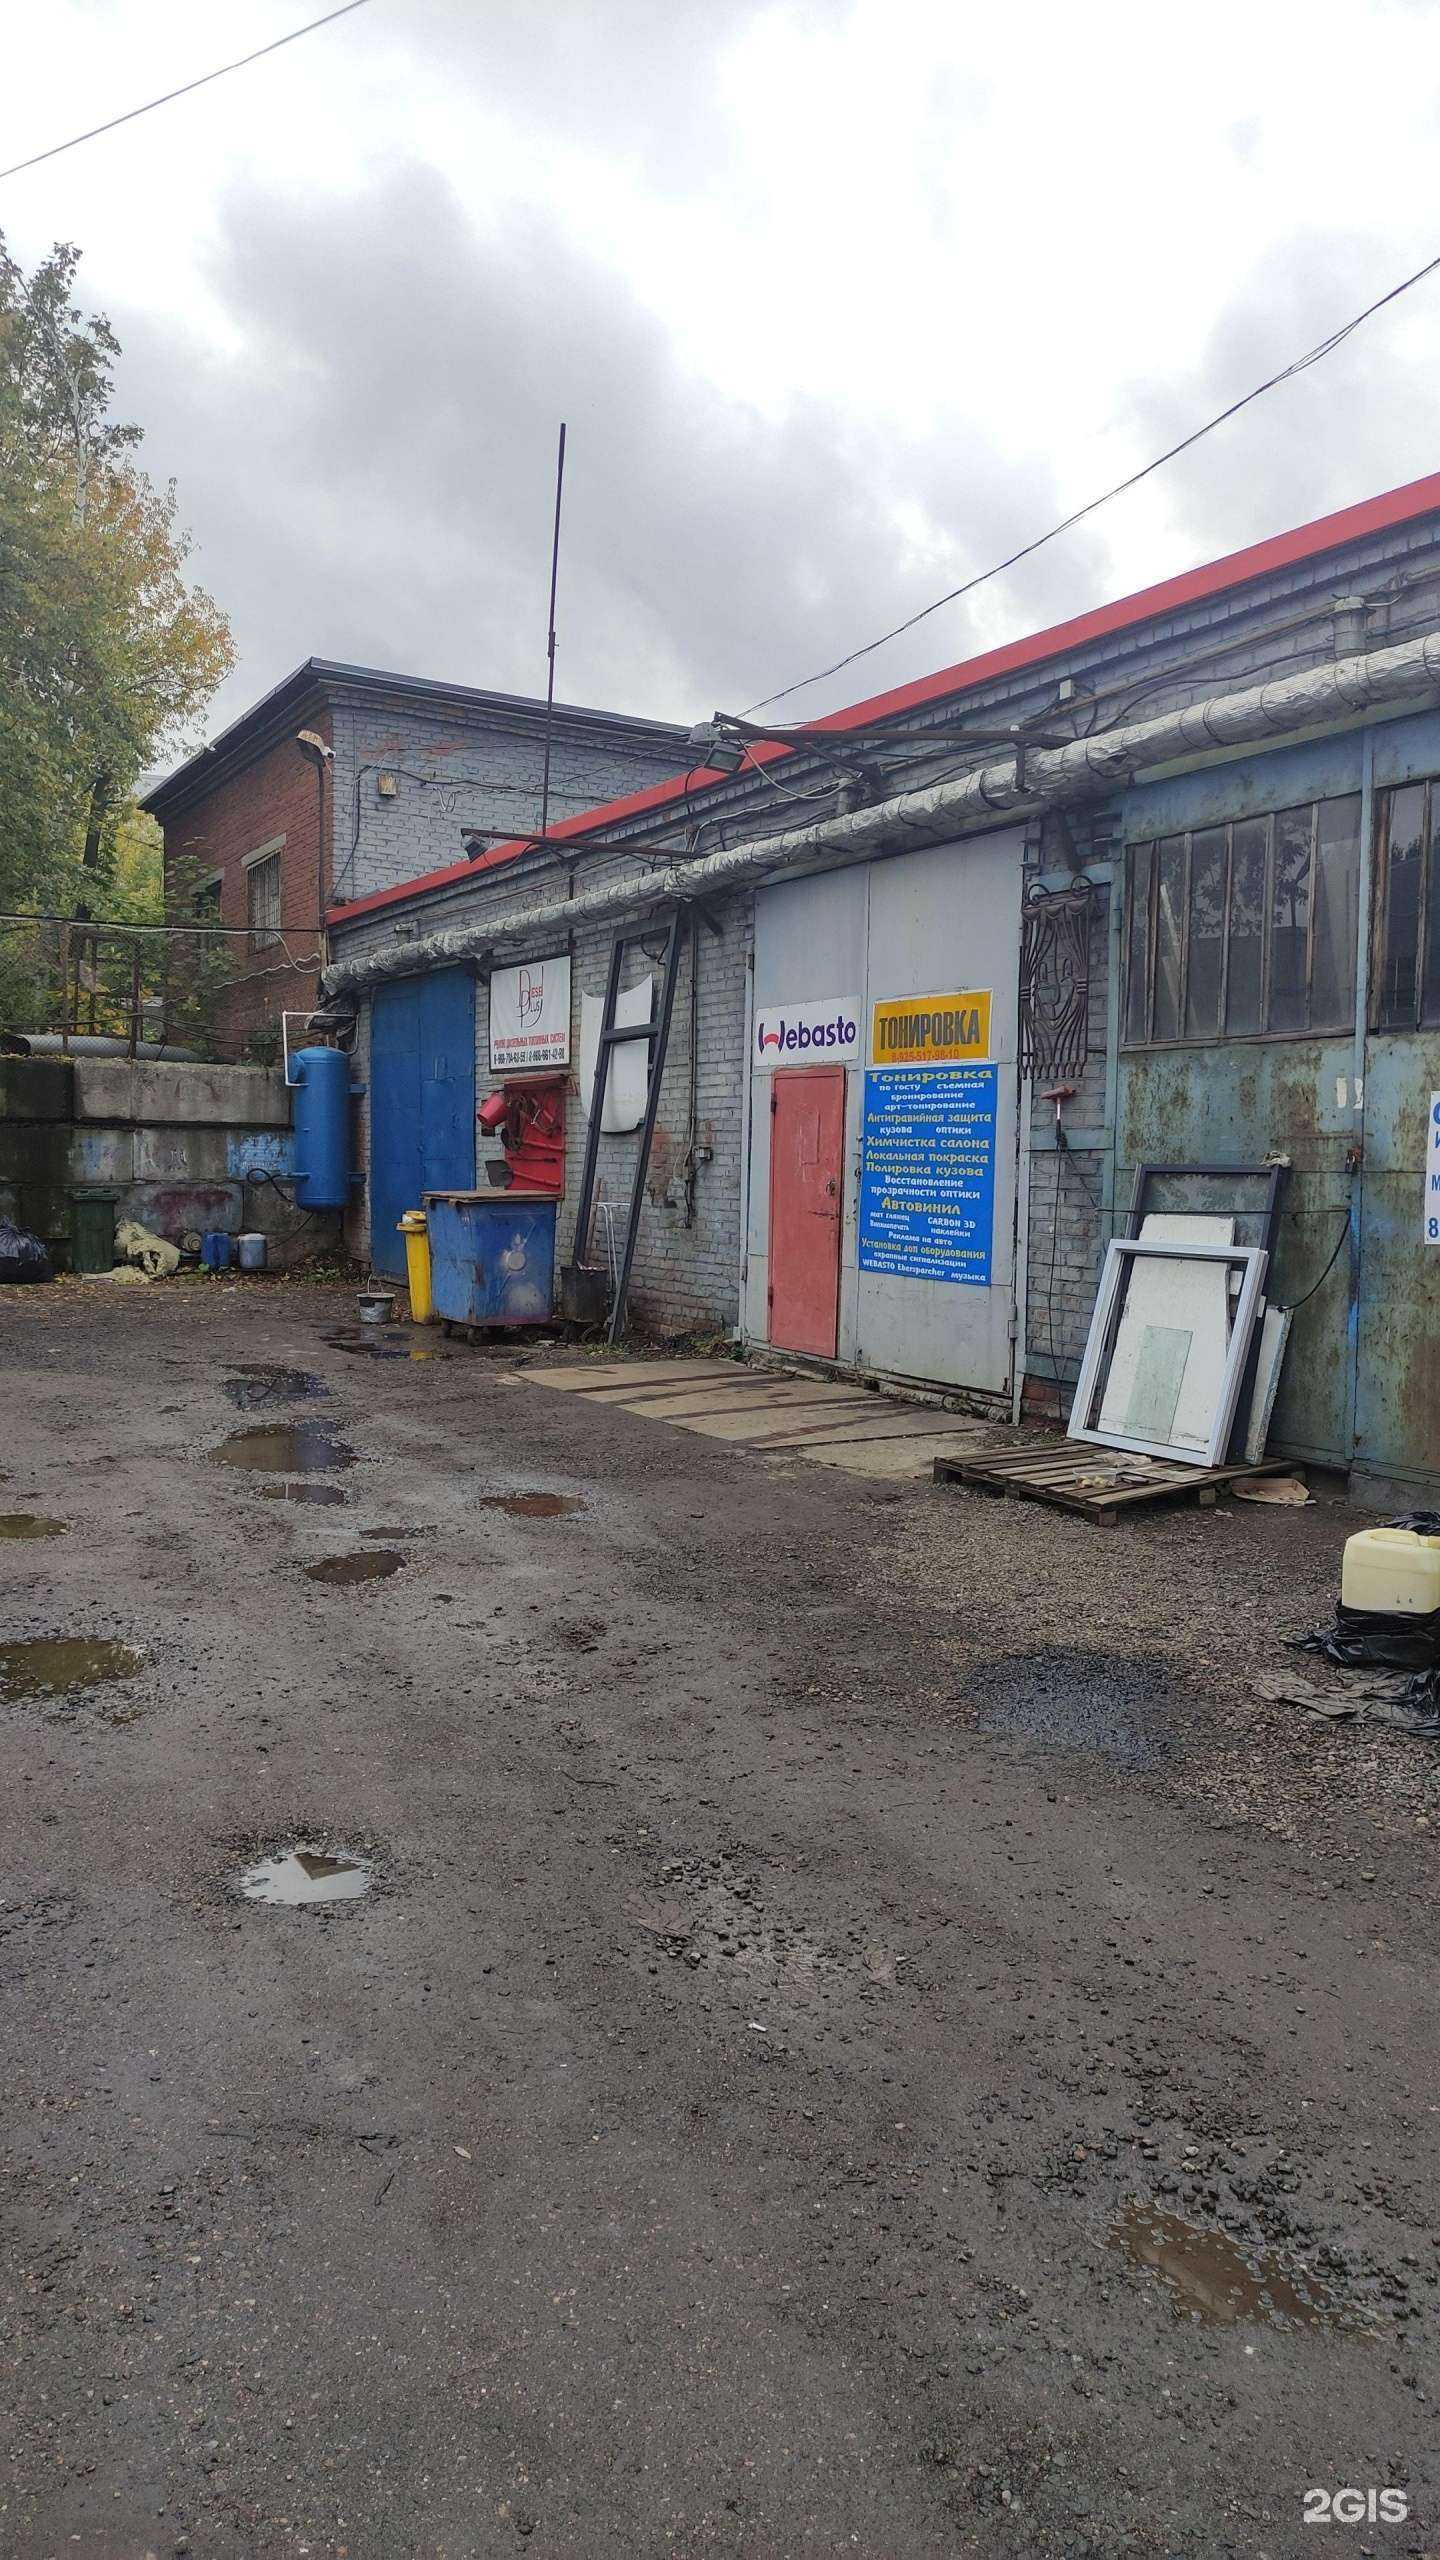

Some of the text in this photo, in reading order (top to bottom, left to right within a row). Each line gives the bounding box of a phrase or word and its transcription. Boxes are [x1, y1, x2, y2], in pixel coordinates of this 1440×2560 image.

[758, 1016, 856, 1054] Webasto
[879, 1008, 980, 1050] ТОНИРОВКА
[870, 1070, 993, 1084] Тонировка
[936, 1082, 985, 1090] съемная
[867, 1112, 992, 1125] Антигравийная защита
[879, 1126, 972, 1136] кузова оптики
[866, 1136, 990, 1149] Химчистка салона
[866, 1150, 989, 1165] Локальная покраска
[865, 1162, 984, 1178] Полировка кузова
[884, 1176, 964, 1188] Восстановление
[870, 1186, 981, 1199] прозрачности оптики
[881, 1197, 961, 1215] Автовинил
[927, 1216, 976, 1229] CARBON 3D
[888, 1231, 920, 1242] Реклама
[934, 1238, 953, 1246] авто
[930, 1228, 971, 1238] наклейки
[861, 1237, 986, 1260] Установка доп оборудования
[862, 1259, 895, 1270] WEBASTO
[950, 1272, 986, 1282] музыка
